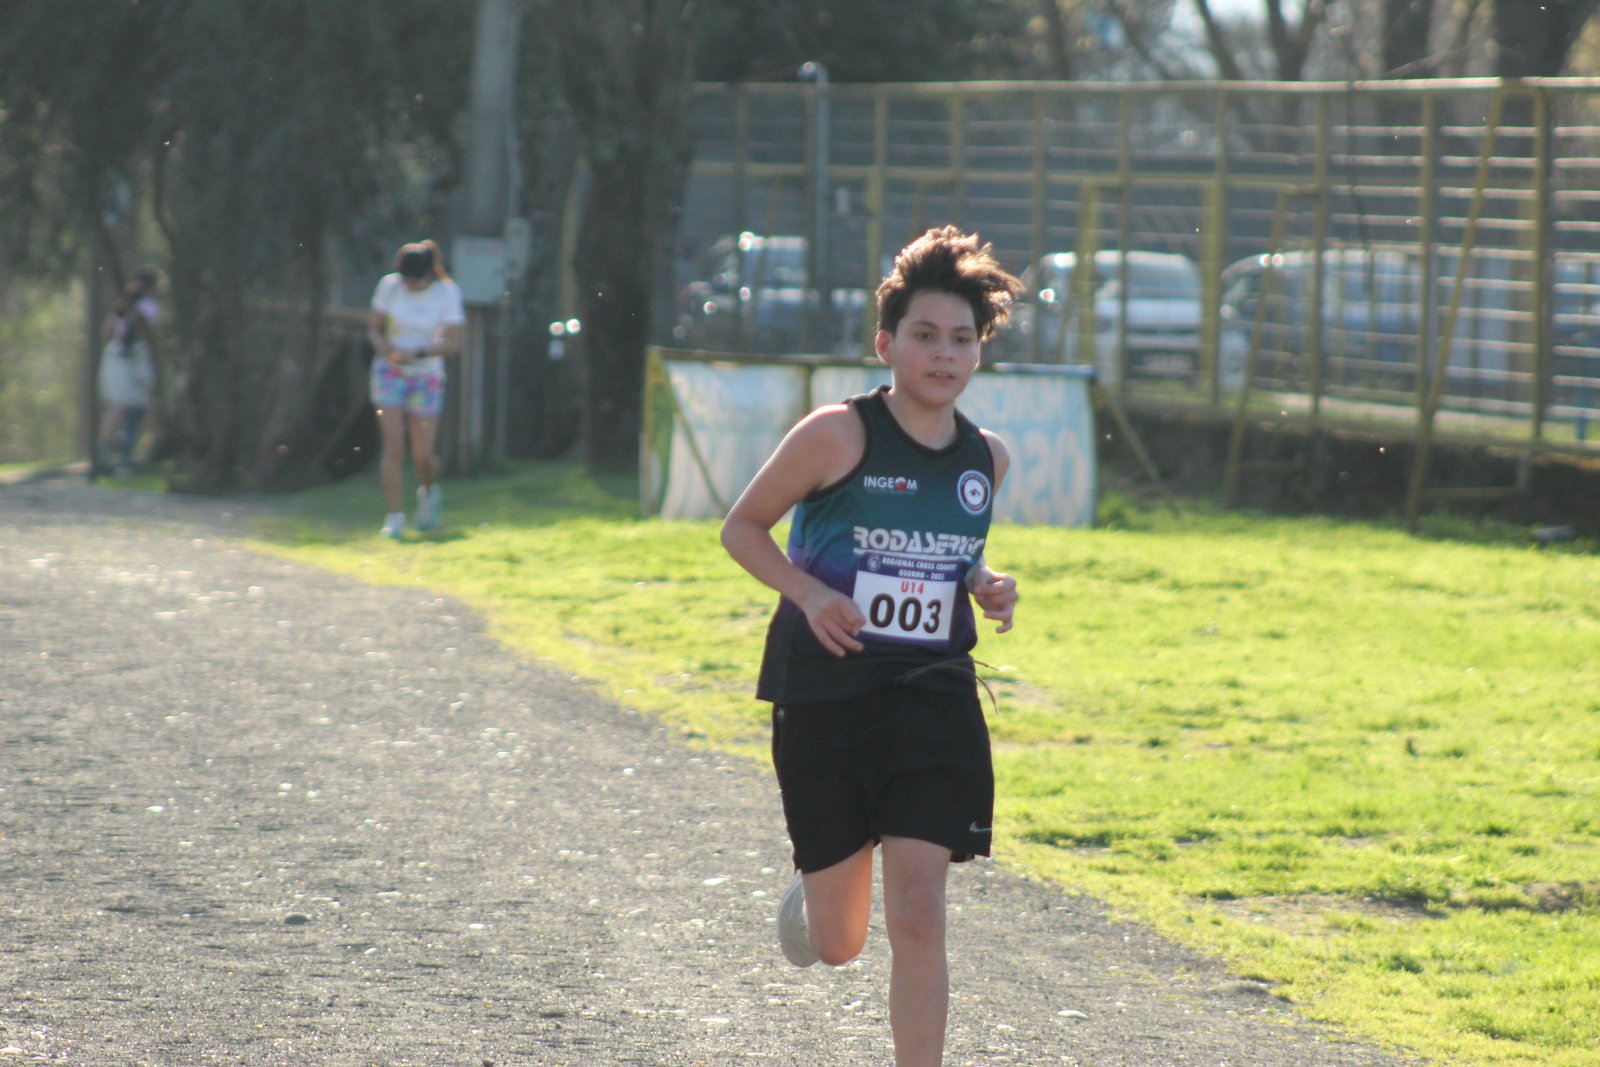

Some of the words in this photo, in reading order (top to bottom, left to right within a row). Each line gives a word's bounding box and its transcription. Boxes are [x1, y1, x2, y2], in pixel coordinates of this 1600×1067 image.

[882, 556, 914, 568] REGIONAL
[916, 561, 935, 570] CROSS
[898, 568, 925, 578] OSORNO
[901, 581, 924, 594] U14
[869, 593, 942, 634] 003
